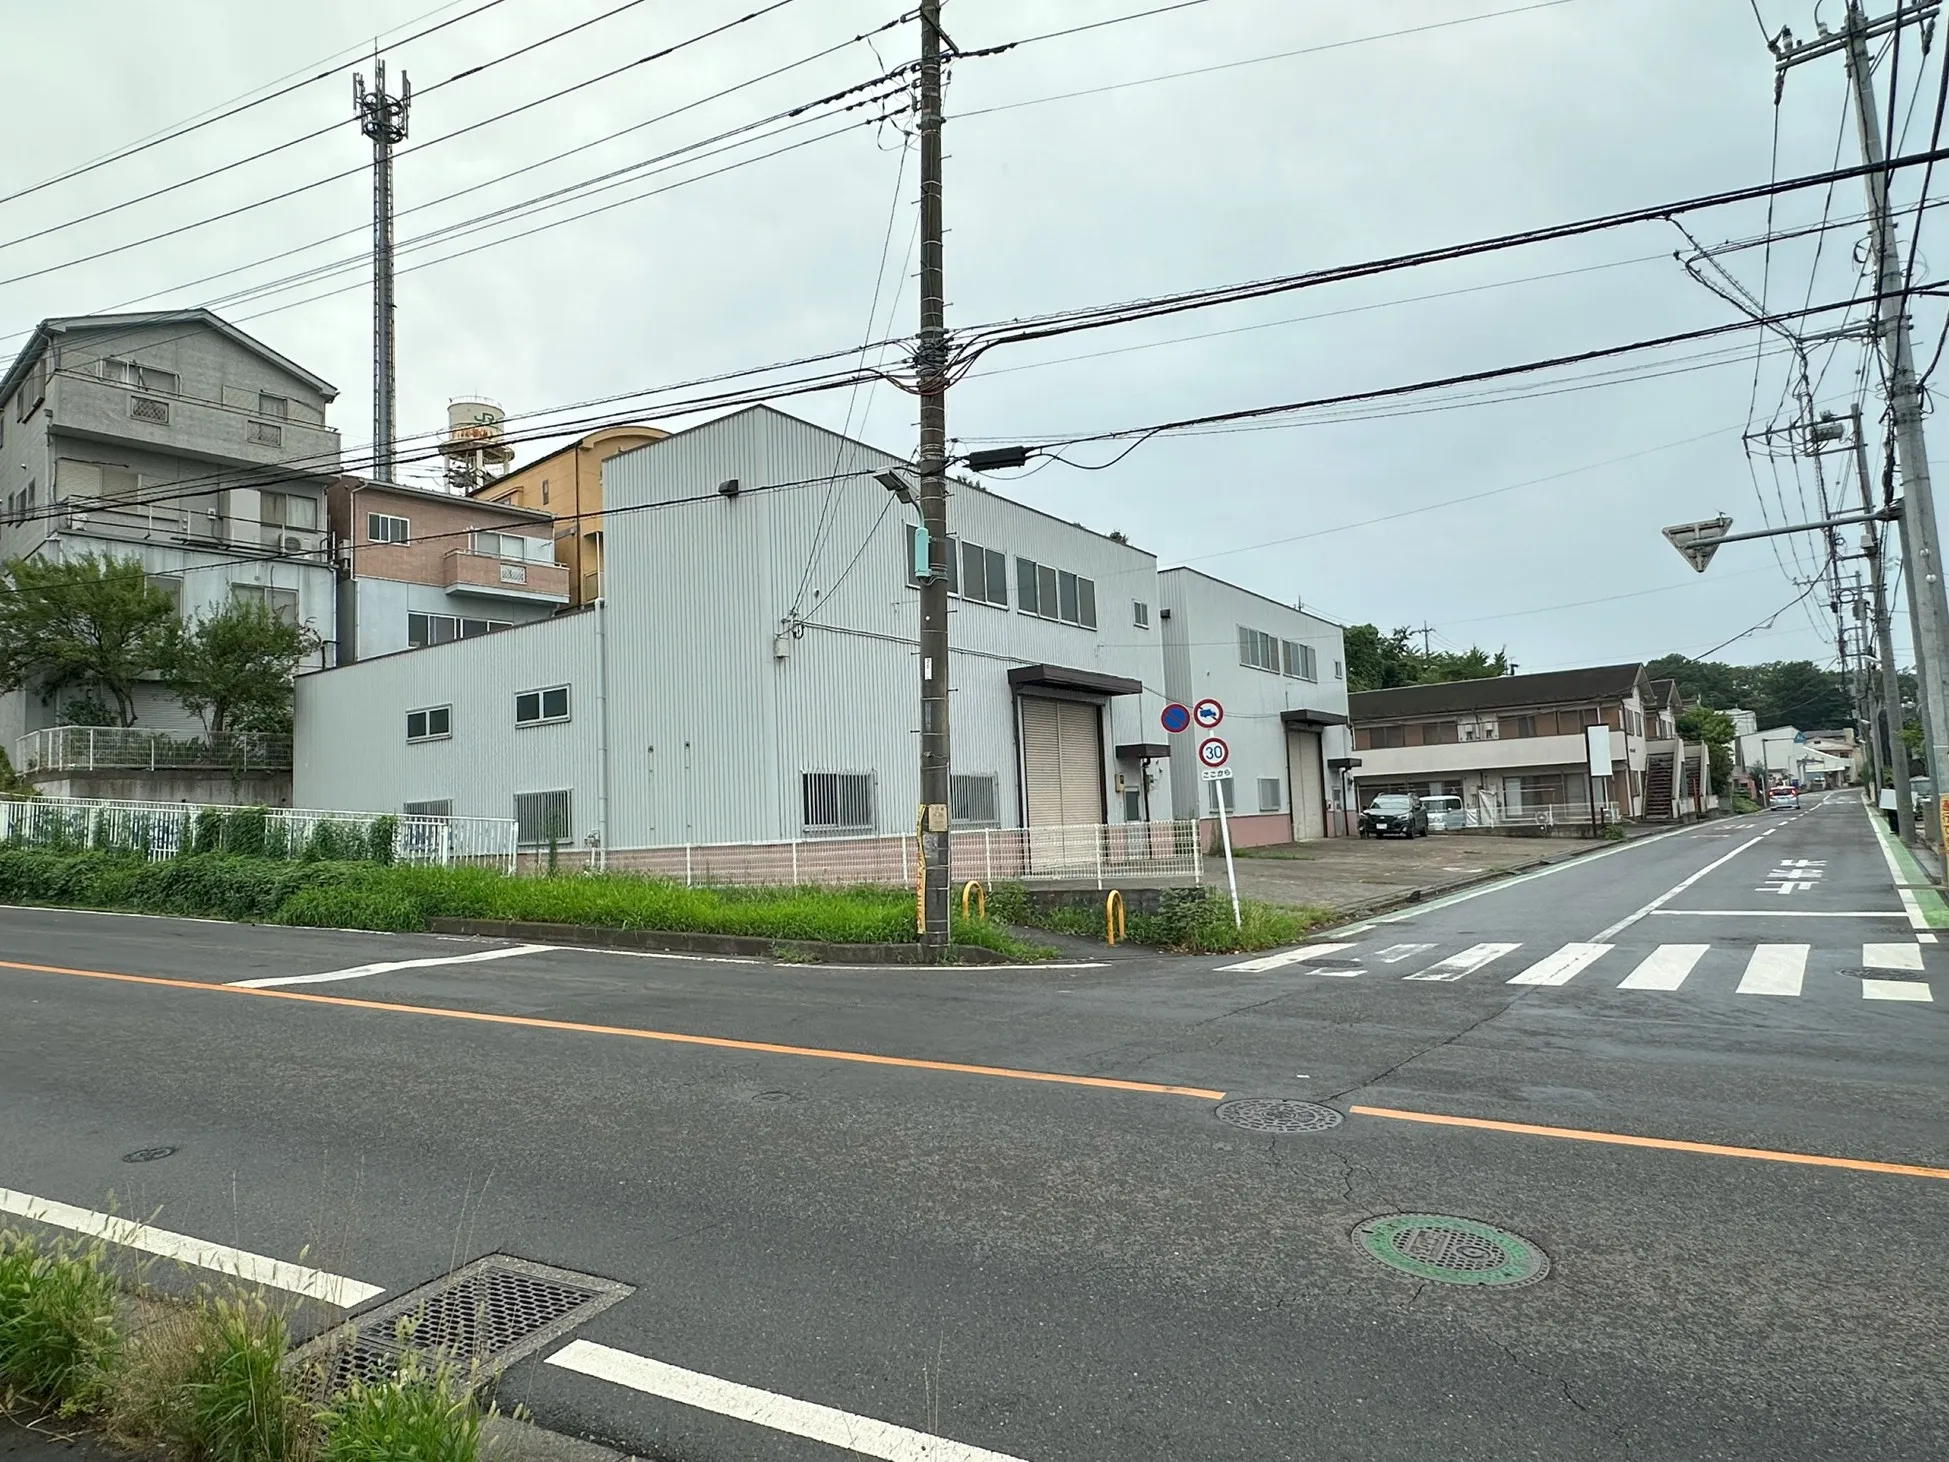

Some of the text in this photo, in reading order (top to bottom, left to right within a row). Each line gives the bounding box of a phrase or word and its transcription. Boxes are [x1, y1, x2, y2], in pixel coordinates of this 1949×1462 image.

[1205, 745, 1223, 760] 30
[1203, 769, 1231, 779] ここから
[1754, 859, 1828, 895] 止まれ
